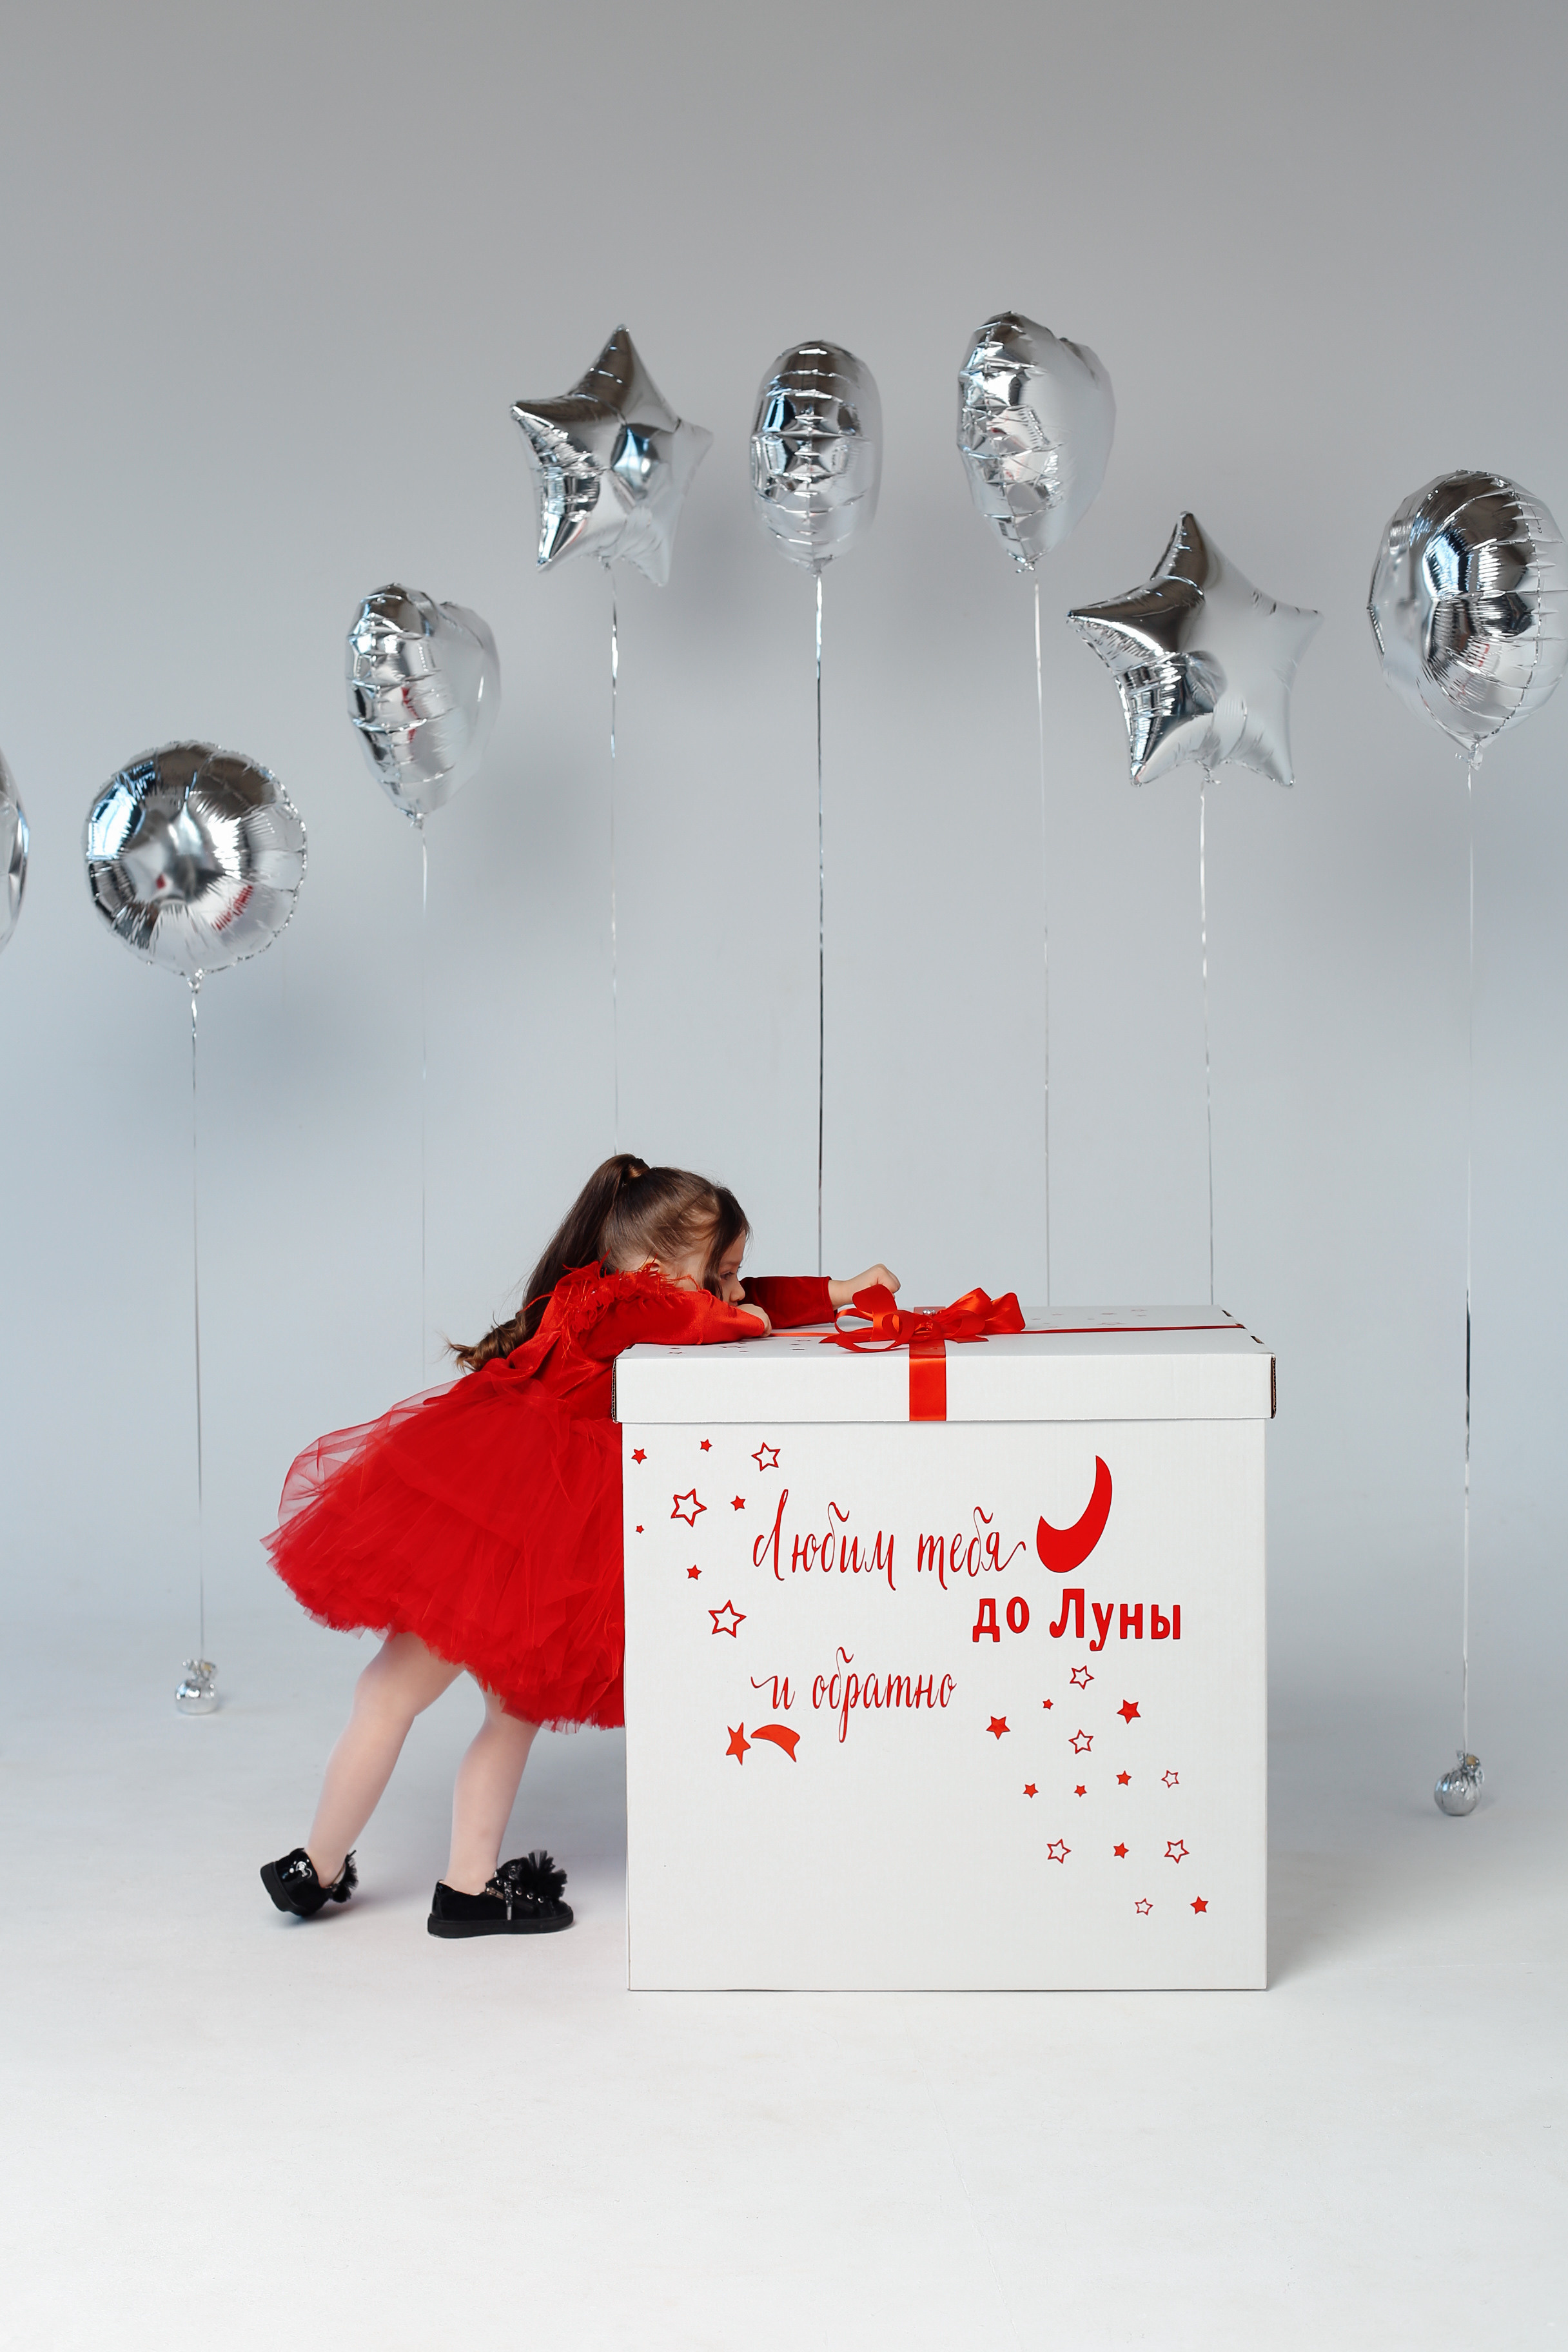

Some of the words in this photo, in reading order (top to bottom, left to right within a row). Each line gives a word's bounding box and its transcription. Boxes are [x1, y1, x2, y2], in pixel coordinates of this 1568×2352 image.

[752, 1489, 897, 1591] Любим
[917, 1505, 1027, 1590] тебя
[972, 1596, 1030, 1643] до
[1049, 1588, 1181, 1652] Луны
[750, 1674, 795, 1710] и
[812, 1647, 957, 1743] обратно
